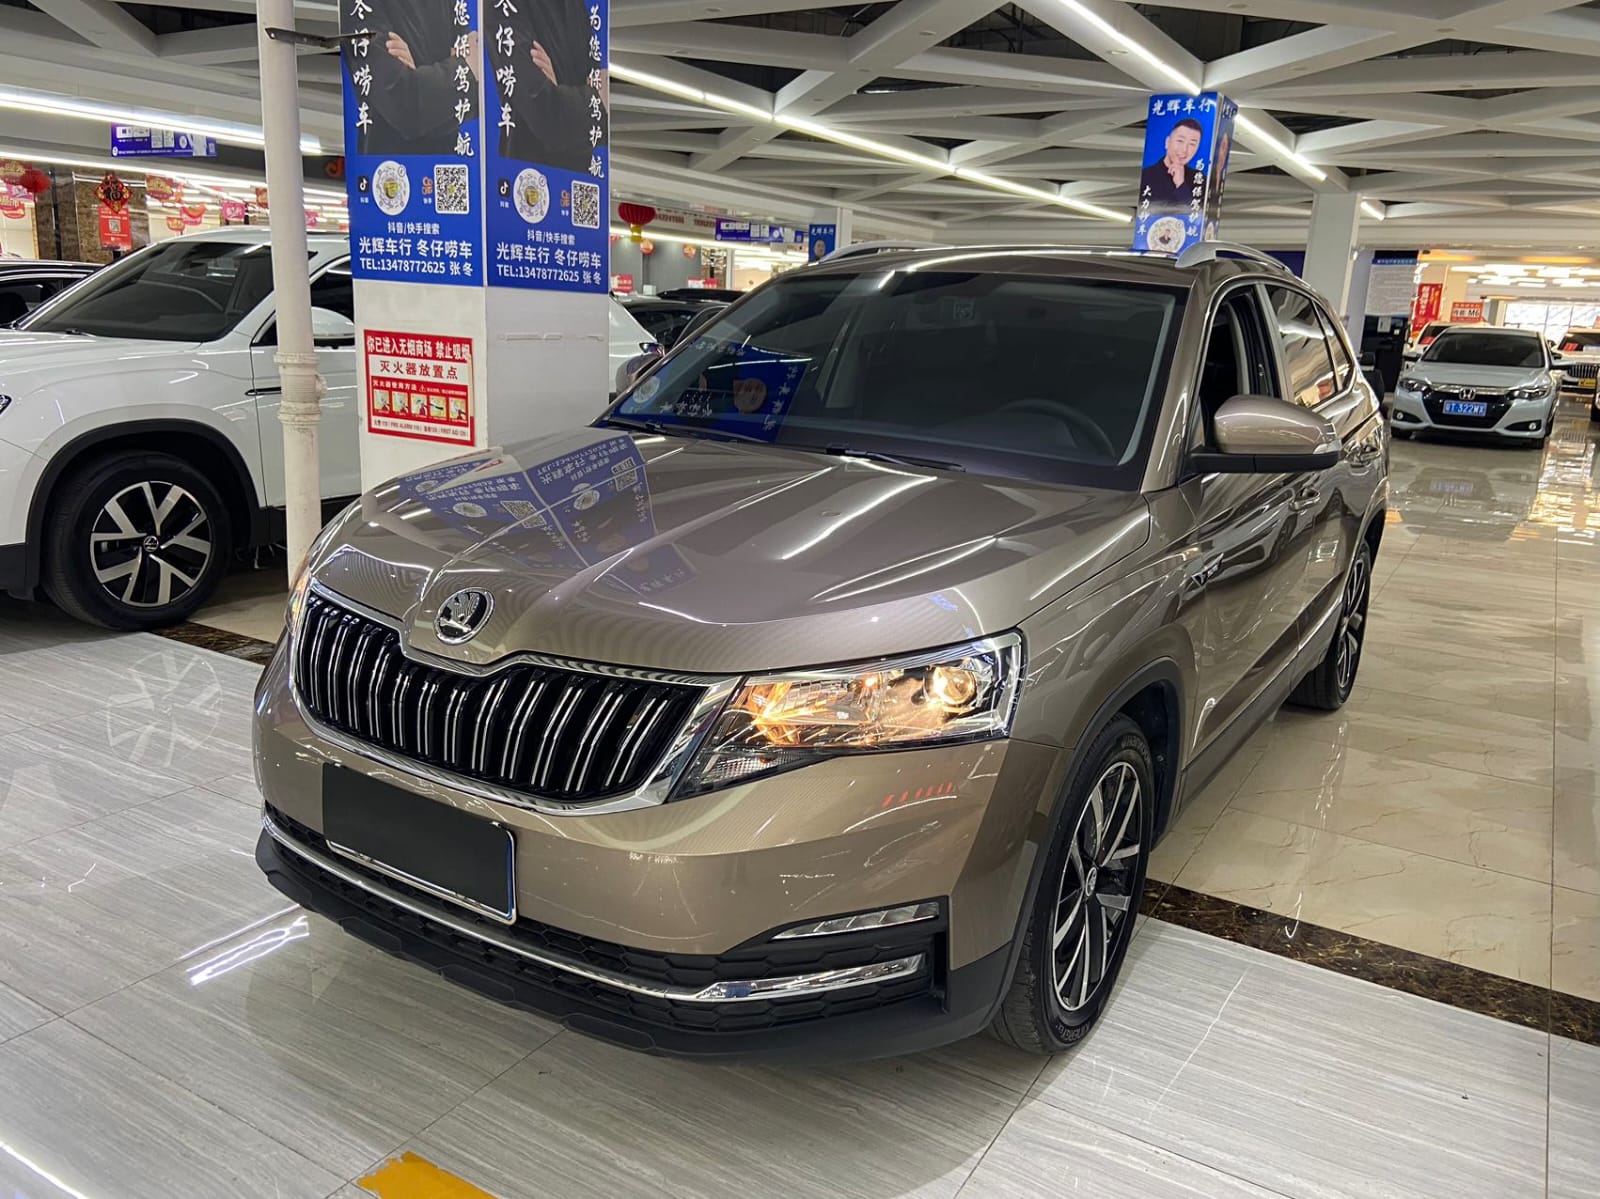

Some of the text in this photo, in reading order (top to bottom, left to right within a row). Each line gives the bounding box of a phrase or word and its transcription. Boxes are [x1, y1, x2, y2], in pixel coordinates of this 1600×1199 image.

[588, 4, 605, 179] 为您保驾护航
[359, 235, 473, 259] 光辉车行 冬仔唠车
[496, 242, 602, 270] 光辉车行 冬仔唠车
[360, 257, 474, 277] TEL:13478772625 张冬
[496, 264, 580, 283] TEL:13478772625
[582, 270, 602, 285] 张冬
[379, 360, 458, 380] 灭火器放置点
